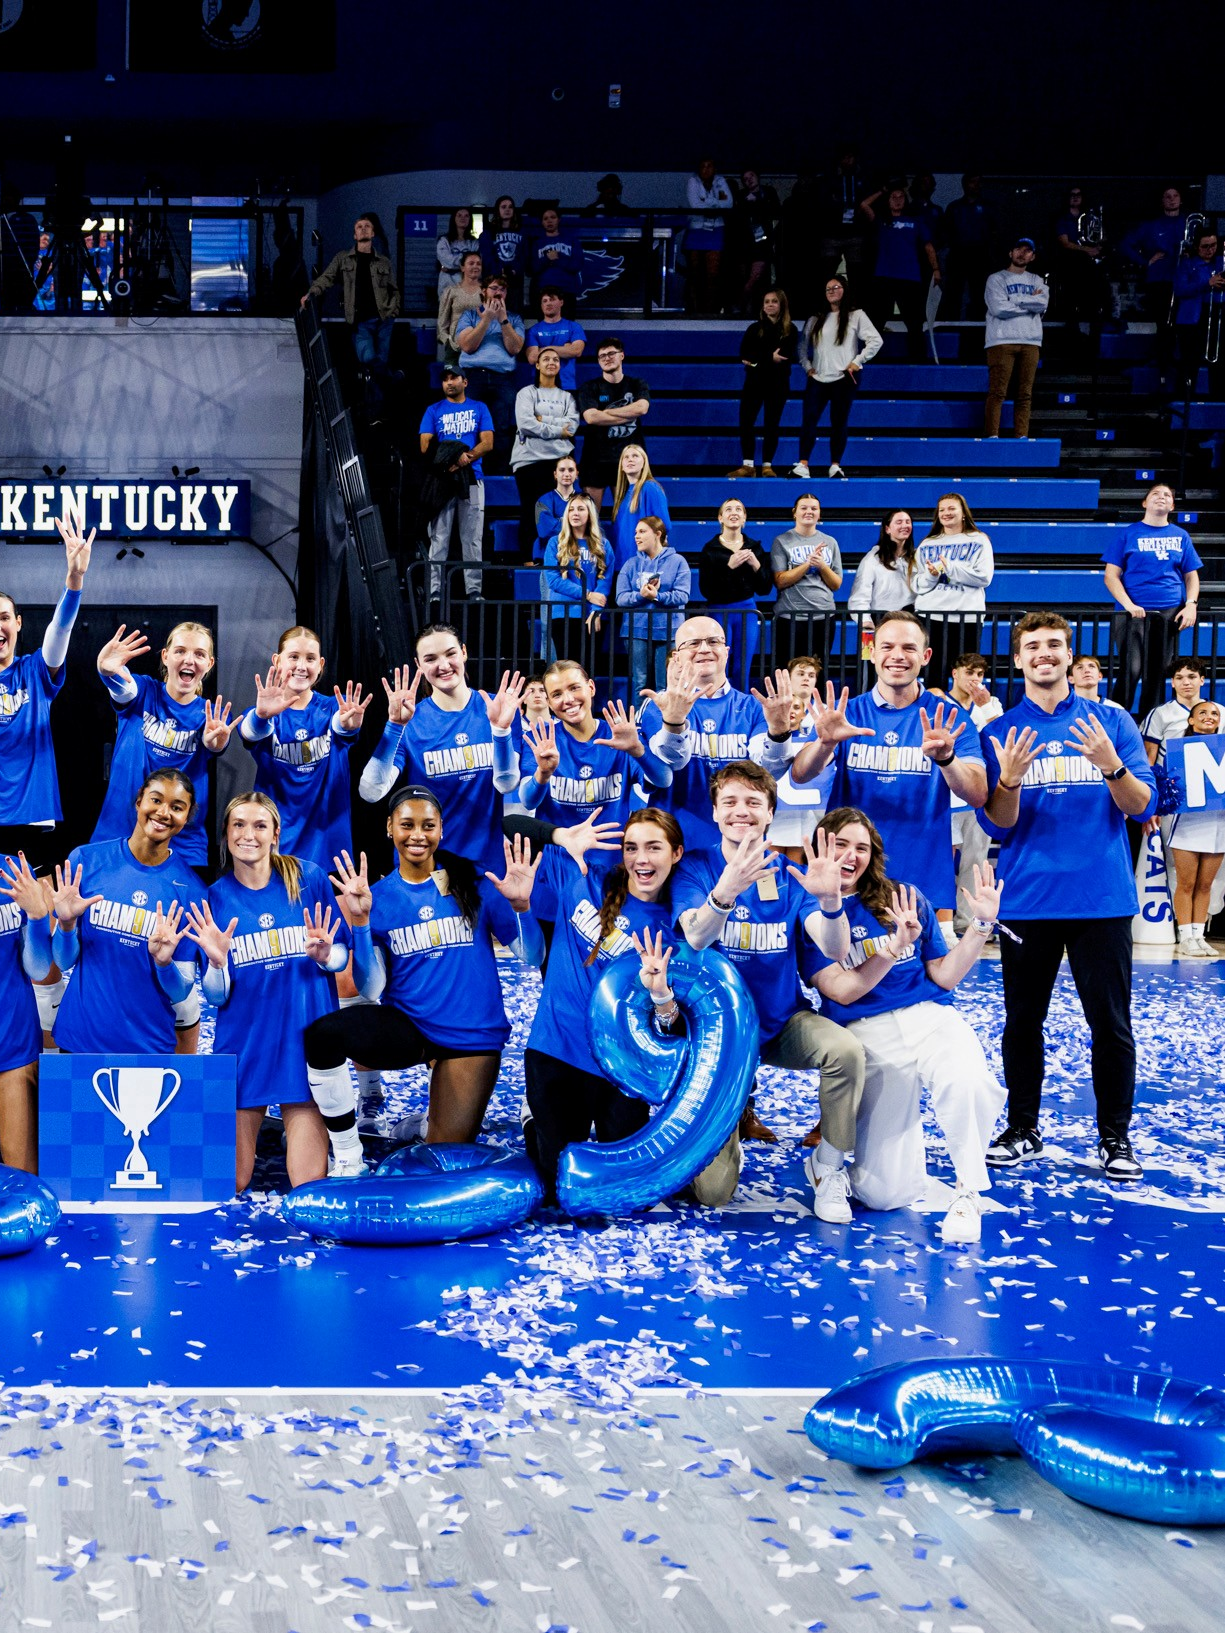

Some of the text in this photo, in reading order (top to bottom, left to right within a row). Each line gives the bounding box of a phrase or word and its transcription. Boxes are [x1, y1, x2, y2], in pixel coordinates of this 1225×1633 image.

[414, 220, 428, 231] 11
[442, 410, 475, 424] WILDCAT
[443, 419, 476, 434] NATION
[1, 486, 238, 531] KENTUCKY
[1137, 537, 1183, 546] KENTUCKY
[920, 542, 983, 563] KENTUCKY
[295, 728, 309, 741] SEC
[1045, 740, 1064, 755] SEC
[423, 742, 494, 776] CHAM9ION
[1142, 830, 1174, 924] CATS
[131, 890, 148, 906] SEC
[417, 905, 434, 921] SEC
[734, 905, 750, 920] SEC
[257, 913, 275, 929] SEC
[387, 916, 474, 955] CHAM9IONS
[852, 925, 868, 939] SEC
